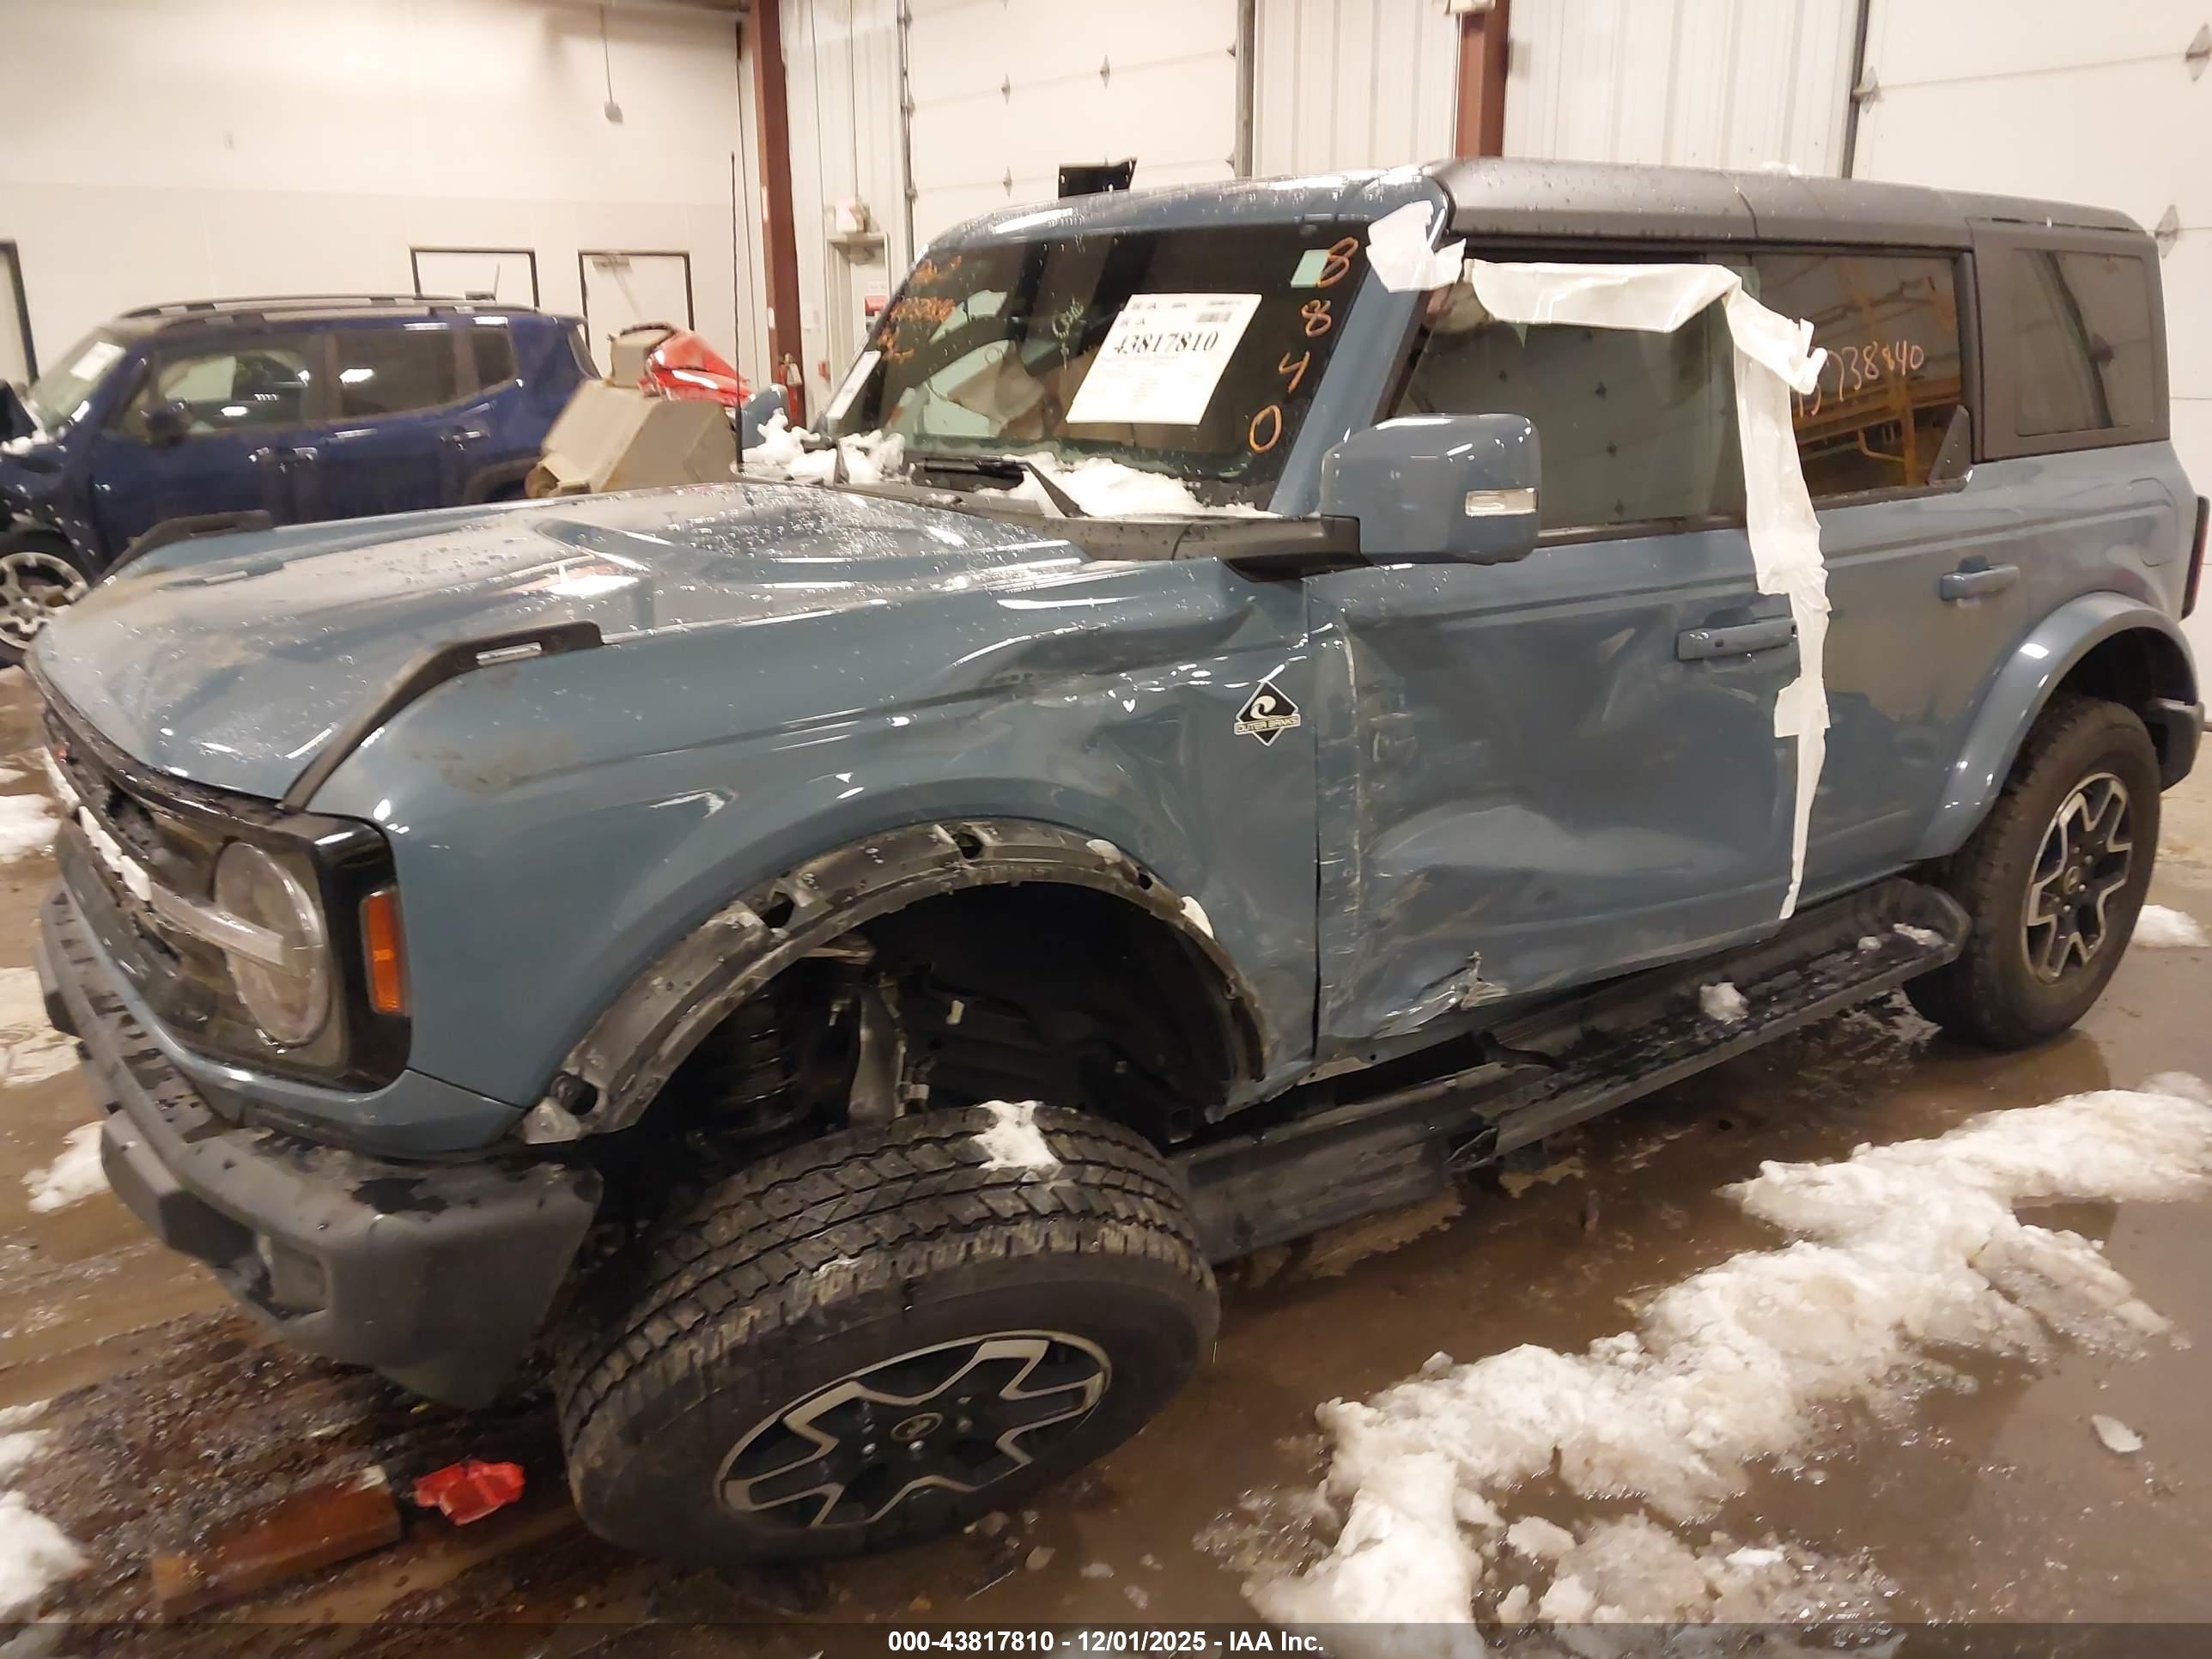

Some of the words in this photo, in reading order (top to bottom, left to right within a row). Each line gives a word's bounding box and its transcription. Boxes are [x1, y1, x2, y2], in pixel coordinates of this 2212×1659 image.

[1114, 331, 1218, 354] 43817810
[1237, 721, 1267, 732] OUTER
[1267, 716, 1298, 728] BANKS
